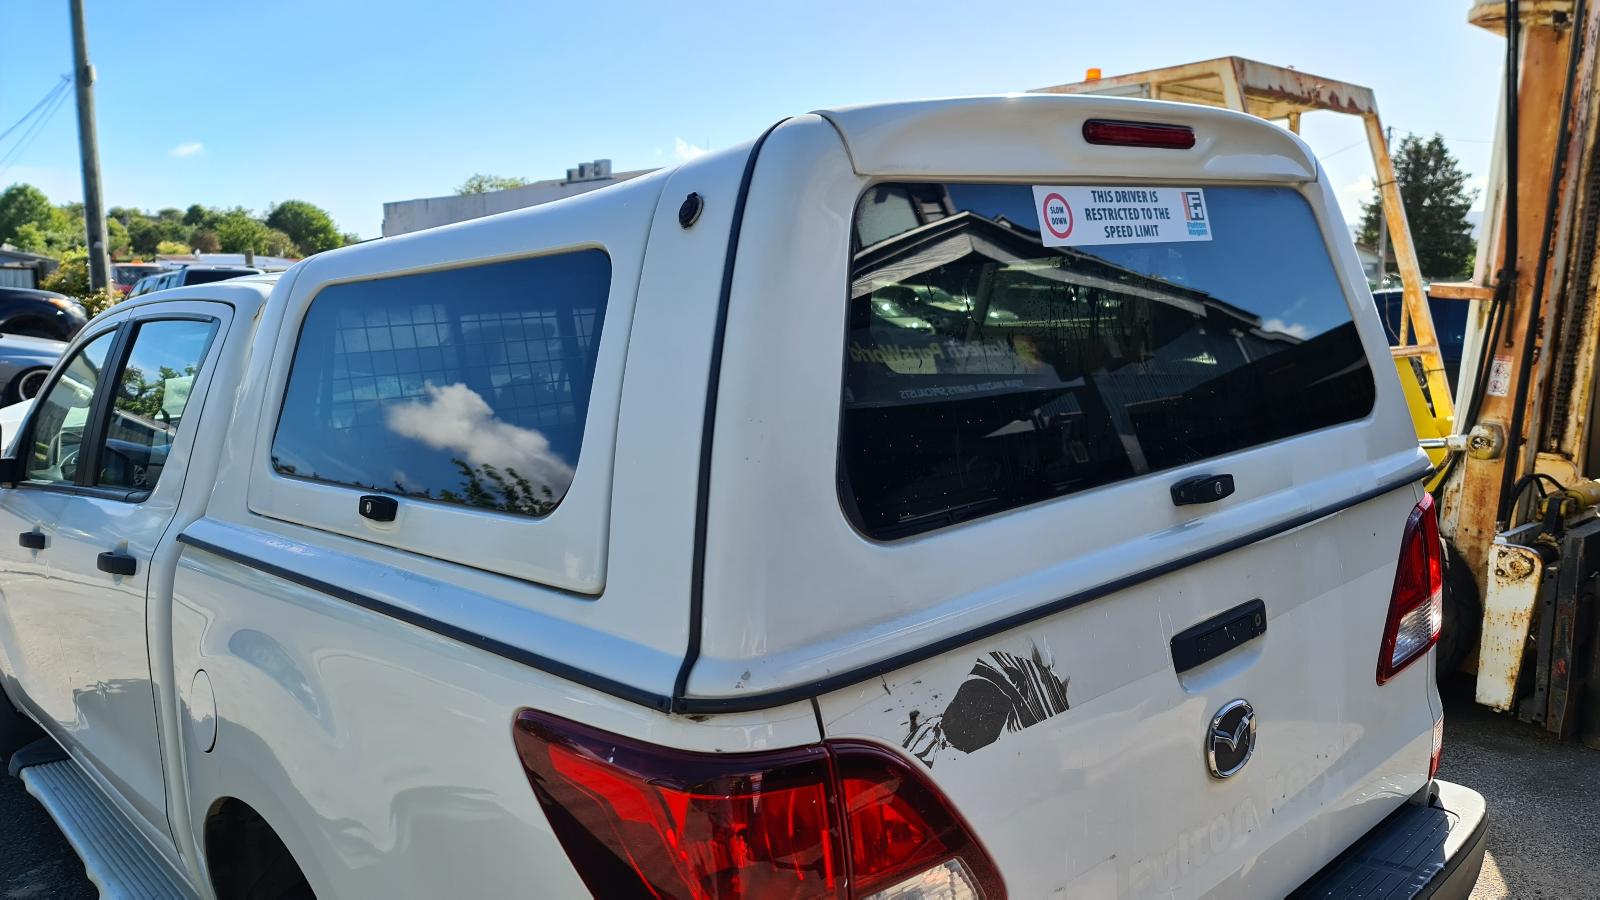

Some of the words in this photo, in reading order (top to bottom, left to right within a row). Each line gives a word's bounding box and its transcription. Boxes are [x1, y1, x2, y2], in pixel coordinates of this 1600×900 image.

[1091, 190, 1114, 203] THIS
[1115, 190, 1149, 203] DRIVER
[1149, 190, 1159, 203] IS
[1049, 206, 1065, 215] SLOW
[1085, 207, 1141, 221] RESTRICTED
[1141, 207, 1153, 220] TO
[1153, 207, 1171, 220] THE
[1051, 217, 1067, 225] DOWN
[1104, 225, 1134, 239] SPEED
[1134, 224, 1160, 238] LIMIT
